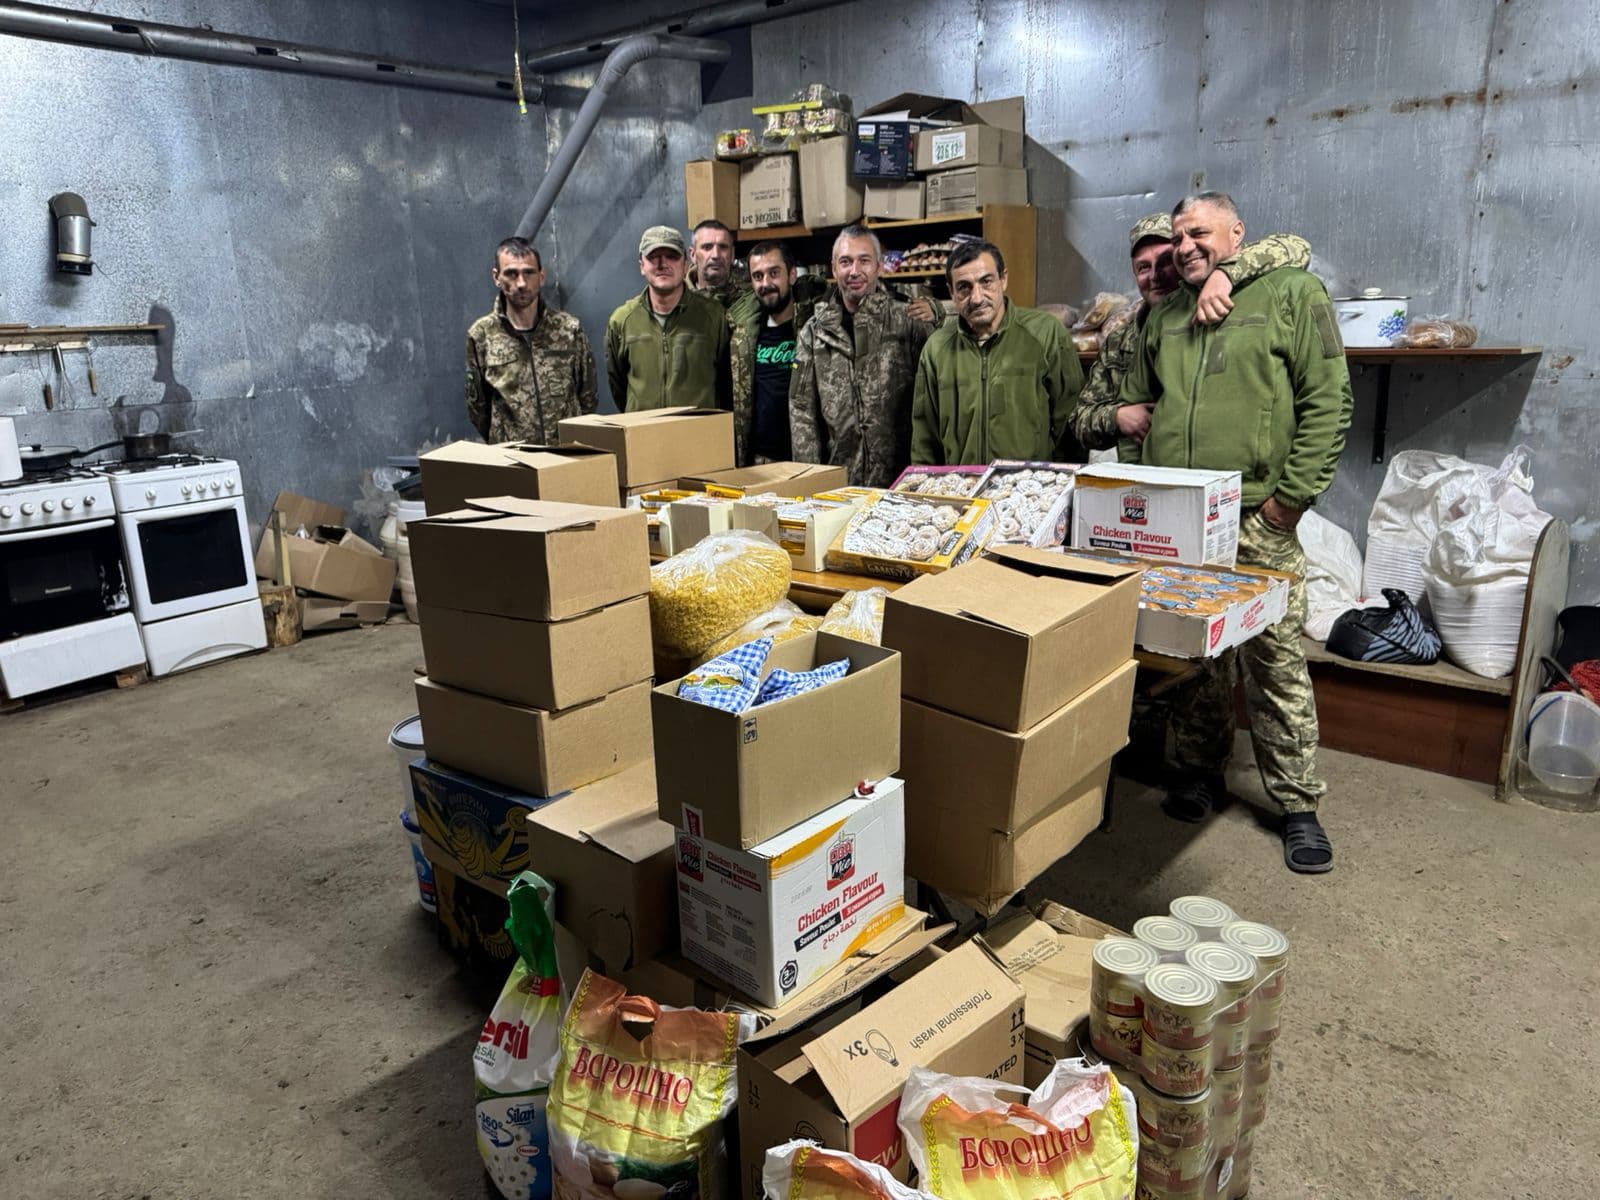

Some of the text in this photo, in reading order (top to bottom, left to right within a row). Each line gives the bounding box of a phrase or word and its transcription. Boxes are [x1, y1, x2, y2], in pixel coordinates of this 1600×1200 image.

[1093, 525, 1172, 544] Chicken Flavour
[798, 897, 840, 932] Chicken
[842, 872, 878, 903] Flavour
[479, 1016, 530, 1060] ersil
[908, 989, 992, 1050] Professional wash
[475, 1045, 496, 1062] RSAL
[506, 1107, 534, 1125] Silan
[959, 1117, 1091, 1169] БОРОШНО
